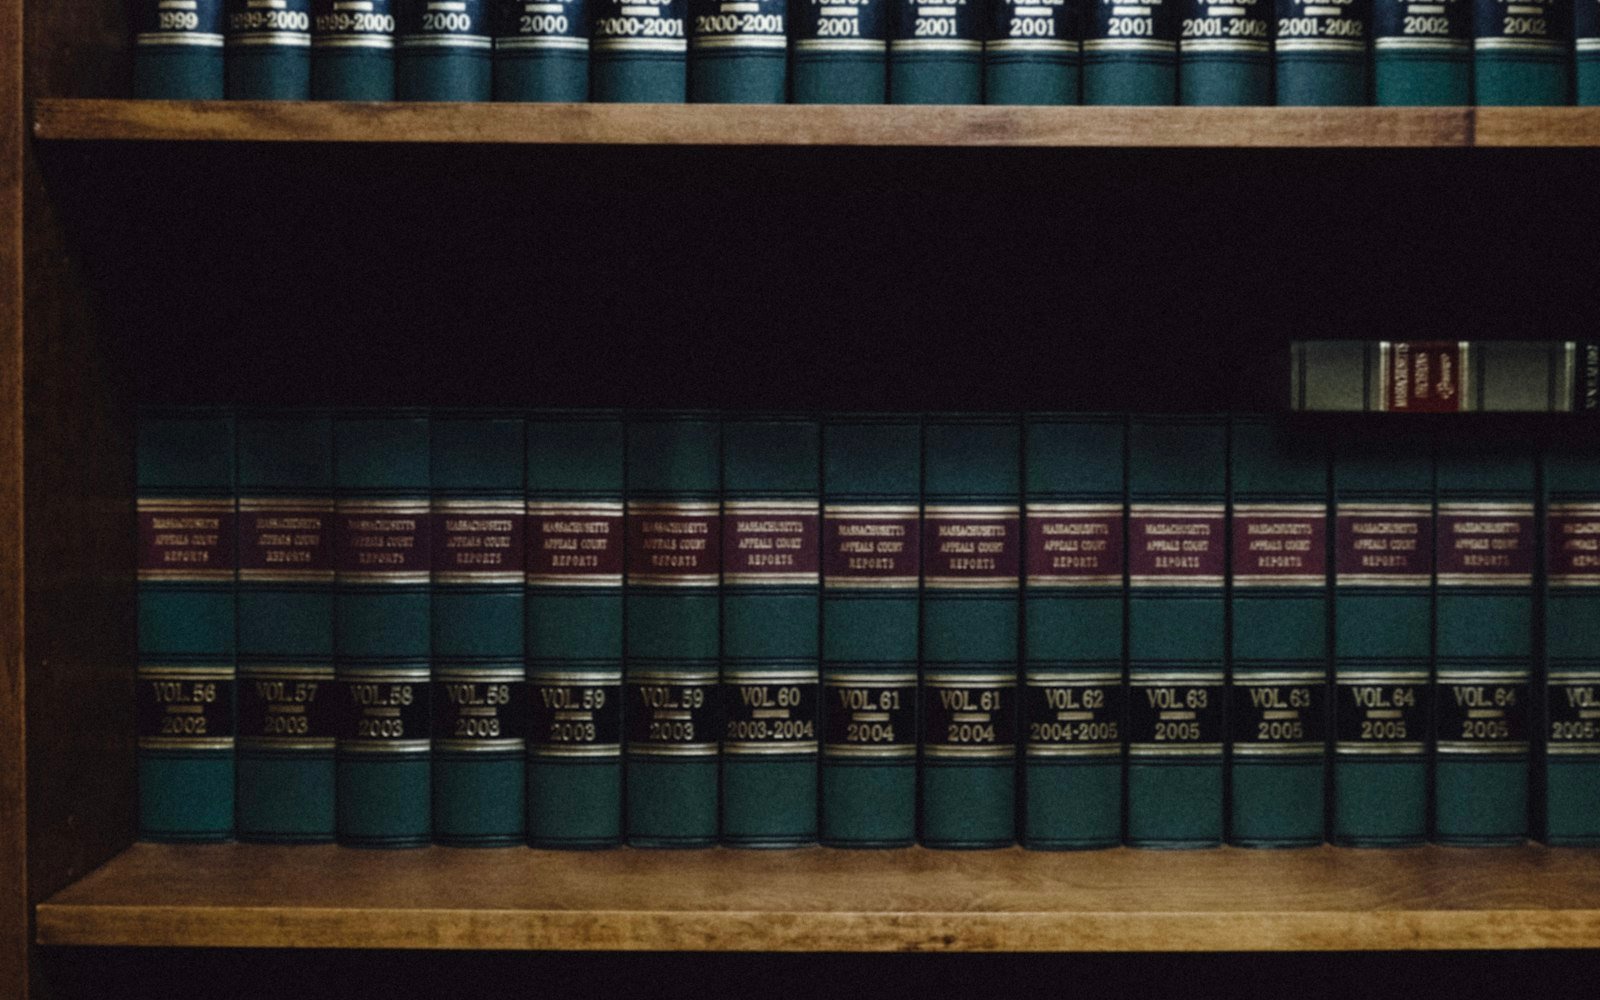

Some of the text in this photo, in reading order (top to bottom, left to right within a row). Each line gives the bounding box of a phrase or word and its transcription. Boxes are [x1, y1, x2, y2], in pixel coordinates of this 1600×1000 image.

[159, 12, 198, 29] 1999
[423, 13, 470, 32] 2000
[520, 15, 568, 33] 2000
[597, 18, 683, 35] 2000-2001
[695, 15, 783, 33] 2000-2001
[817, 18, 859, 36] 2001
[915, 18, 957, 36] 2001
[1010, 18, 1055, 36] 2001
[1108, 18, 1153, 36] 2001
[1182, 18, 1268, 36] 2001-2002
[1278, 18, 1363, 36] 2001-2002
[1403, 17, 1448, 34] 2002
[1504, 17, 1546, 34] 2002
[748, 554, 793, 565] REPORTS
[849, 558, 894, 568] REPORTS
[950, 558, 995, 570] REPORTS
[162, 716, 206, 734] 2002
[264, 716, 308, 734] 2003
[359, 720, 403, 737] 2003
[455, 719, 500, 737] 2003
[550, 723, 596, 741] 2003
[650, 722, 694, 740] 2003
[728, 720, 814, 739] 2003-2004
[848, 724, 894, 741] 2004
[948, 724, 994, 742] 2004
[1030, 722, 1118, 740] 2004-2005
[1154, 722, 1200, 740] 2005
[1258, 722, 1303, 739] 2005
[1361, 722, 1406, 739] 2005
[1462, 722, 1508, 738] 2005
